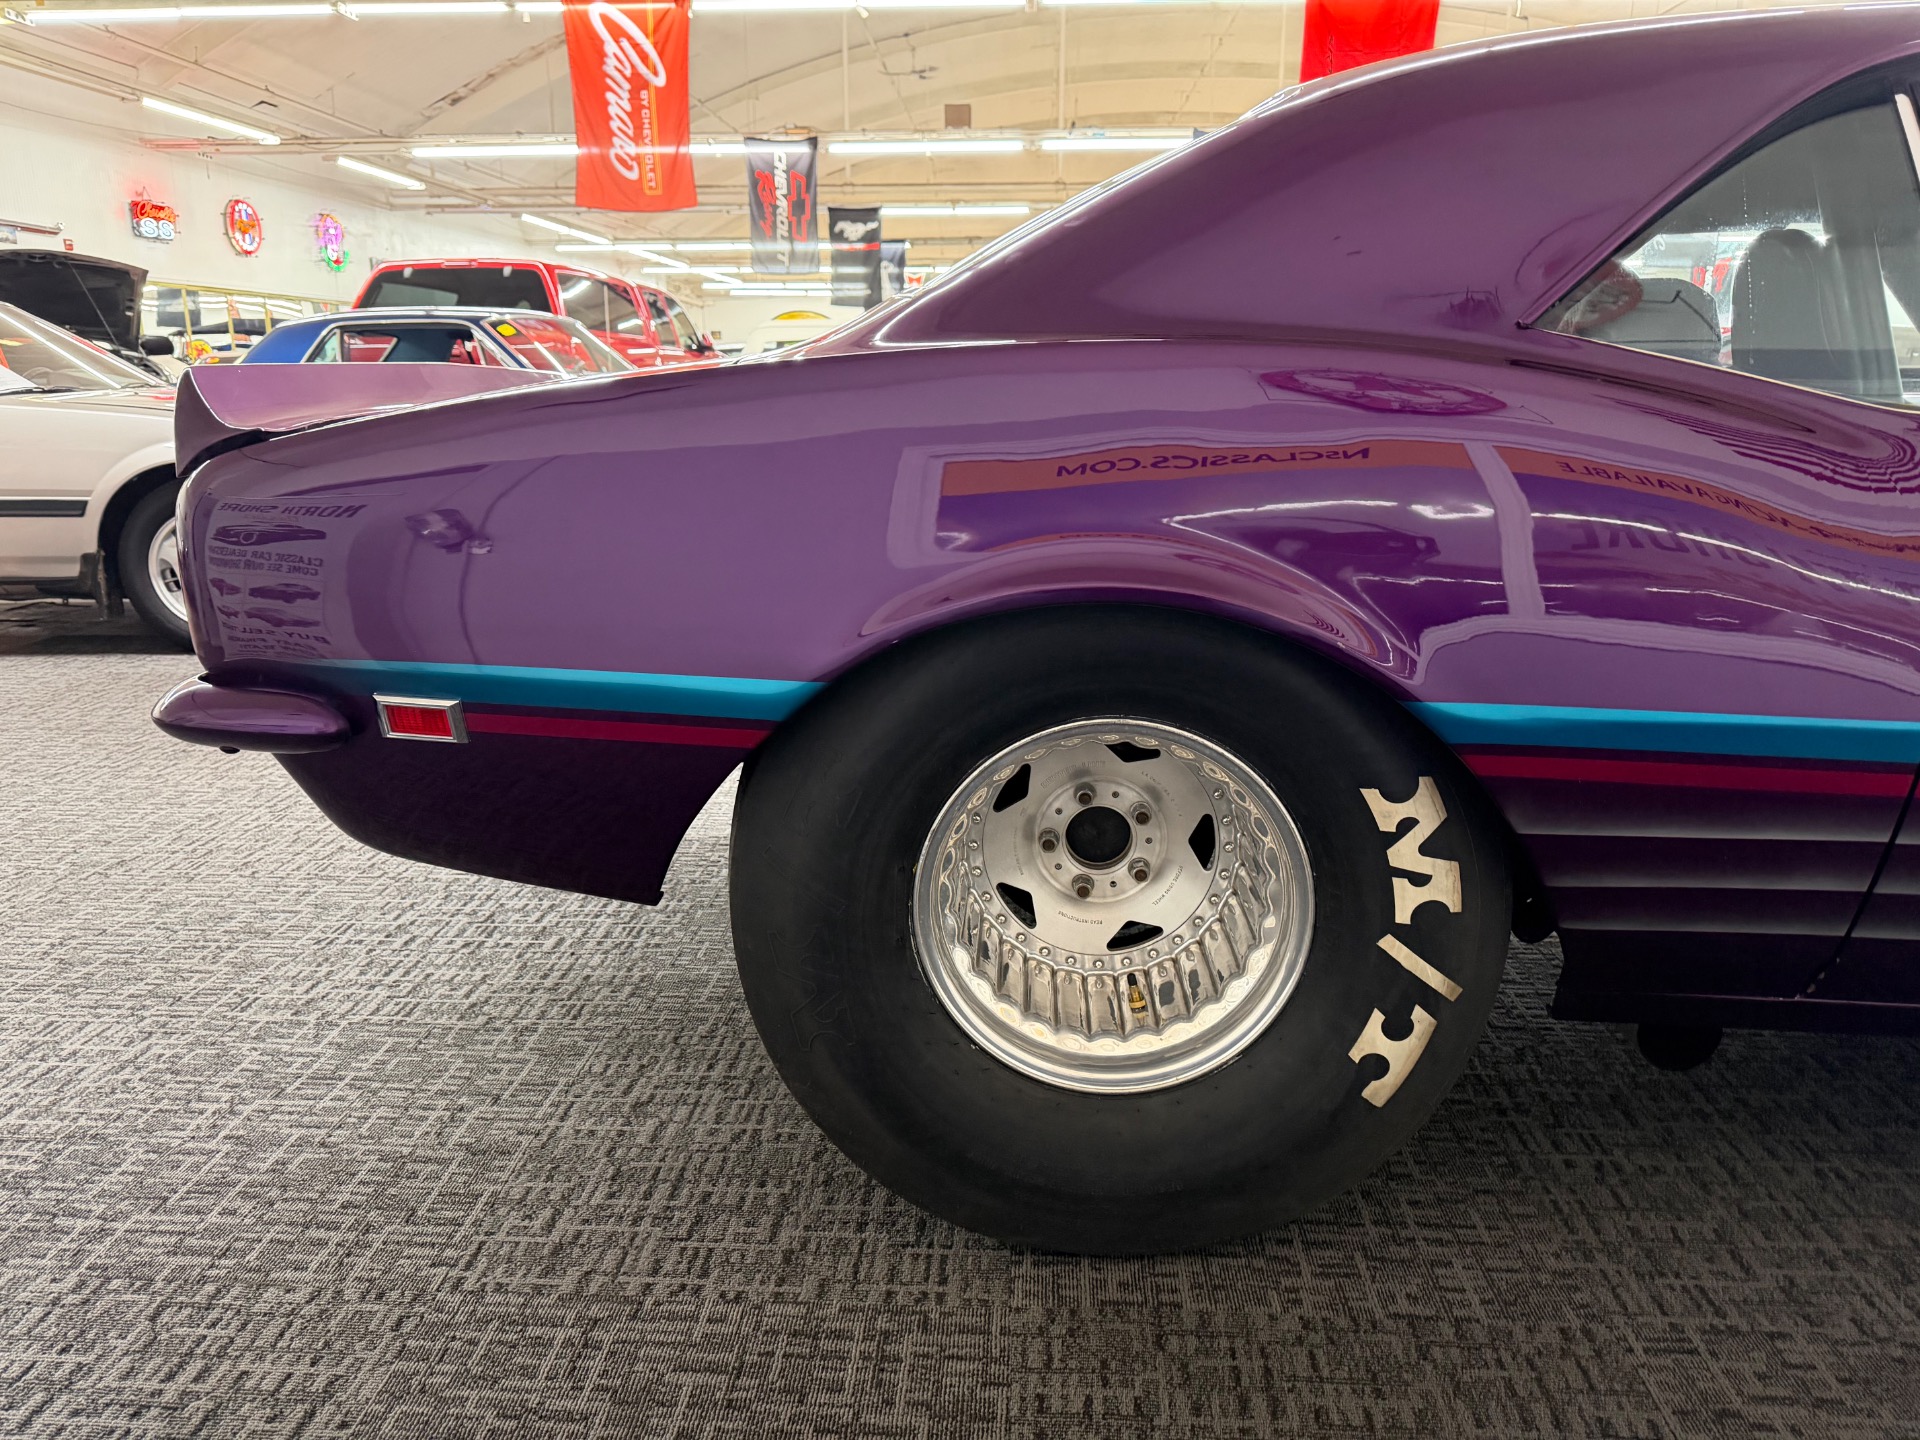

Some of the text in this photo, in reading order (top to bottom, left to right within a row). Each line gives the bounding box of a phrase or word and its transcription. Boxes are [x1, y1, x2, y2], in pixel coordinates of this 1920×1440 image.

[588, 2, 667, 182] Camaro
[640, 90, 650, 108] BY
[140, 217, 175, 240] SS
